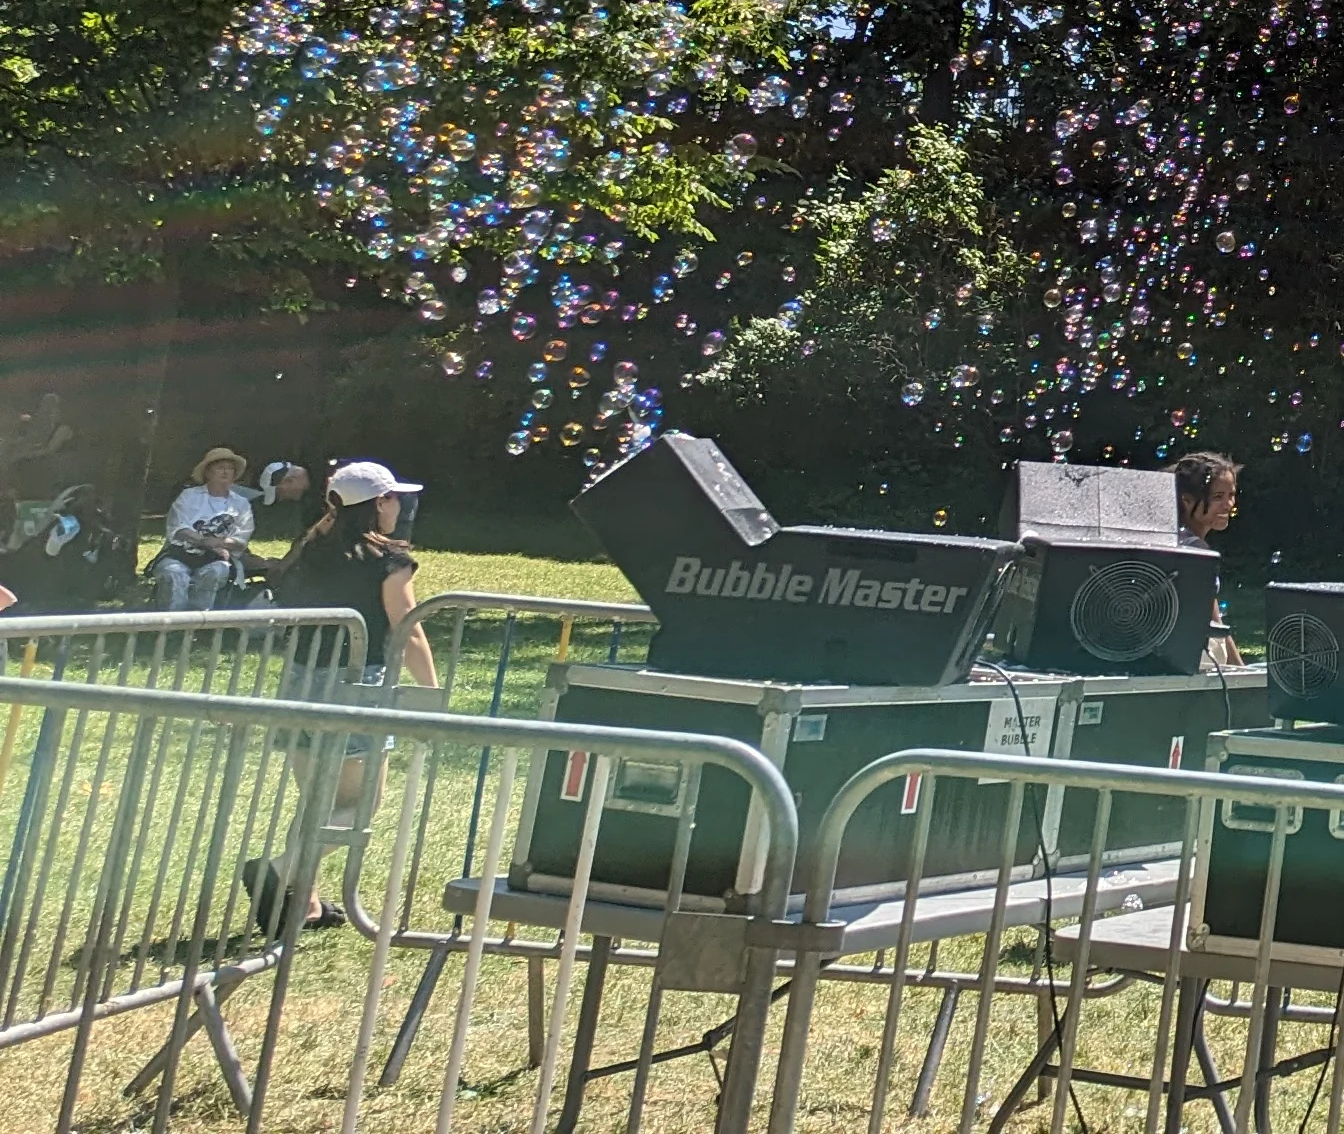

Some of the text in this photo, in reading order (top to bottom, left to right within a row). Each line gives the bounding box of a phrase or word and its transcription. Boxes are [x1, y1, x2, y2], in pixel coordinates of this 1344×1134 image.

[663, 556, 814, 604] Bubble
[817, 566, 969, 614] Master
[1003, 715, 1041, 728] MATER
